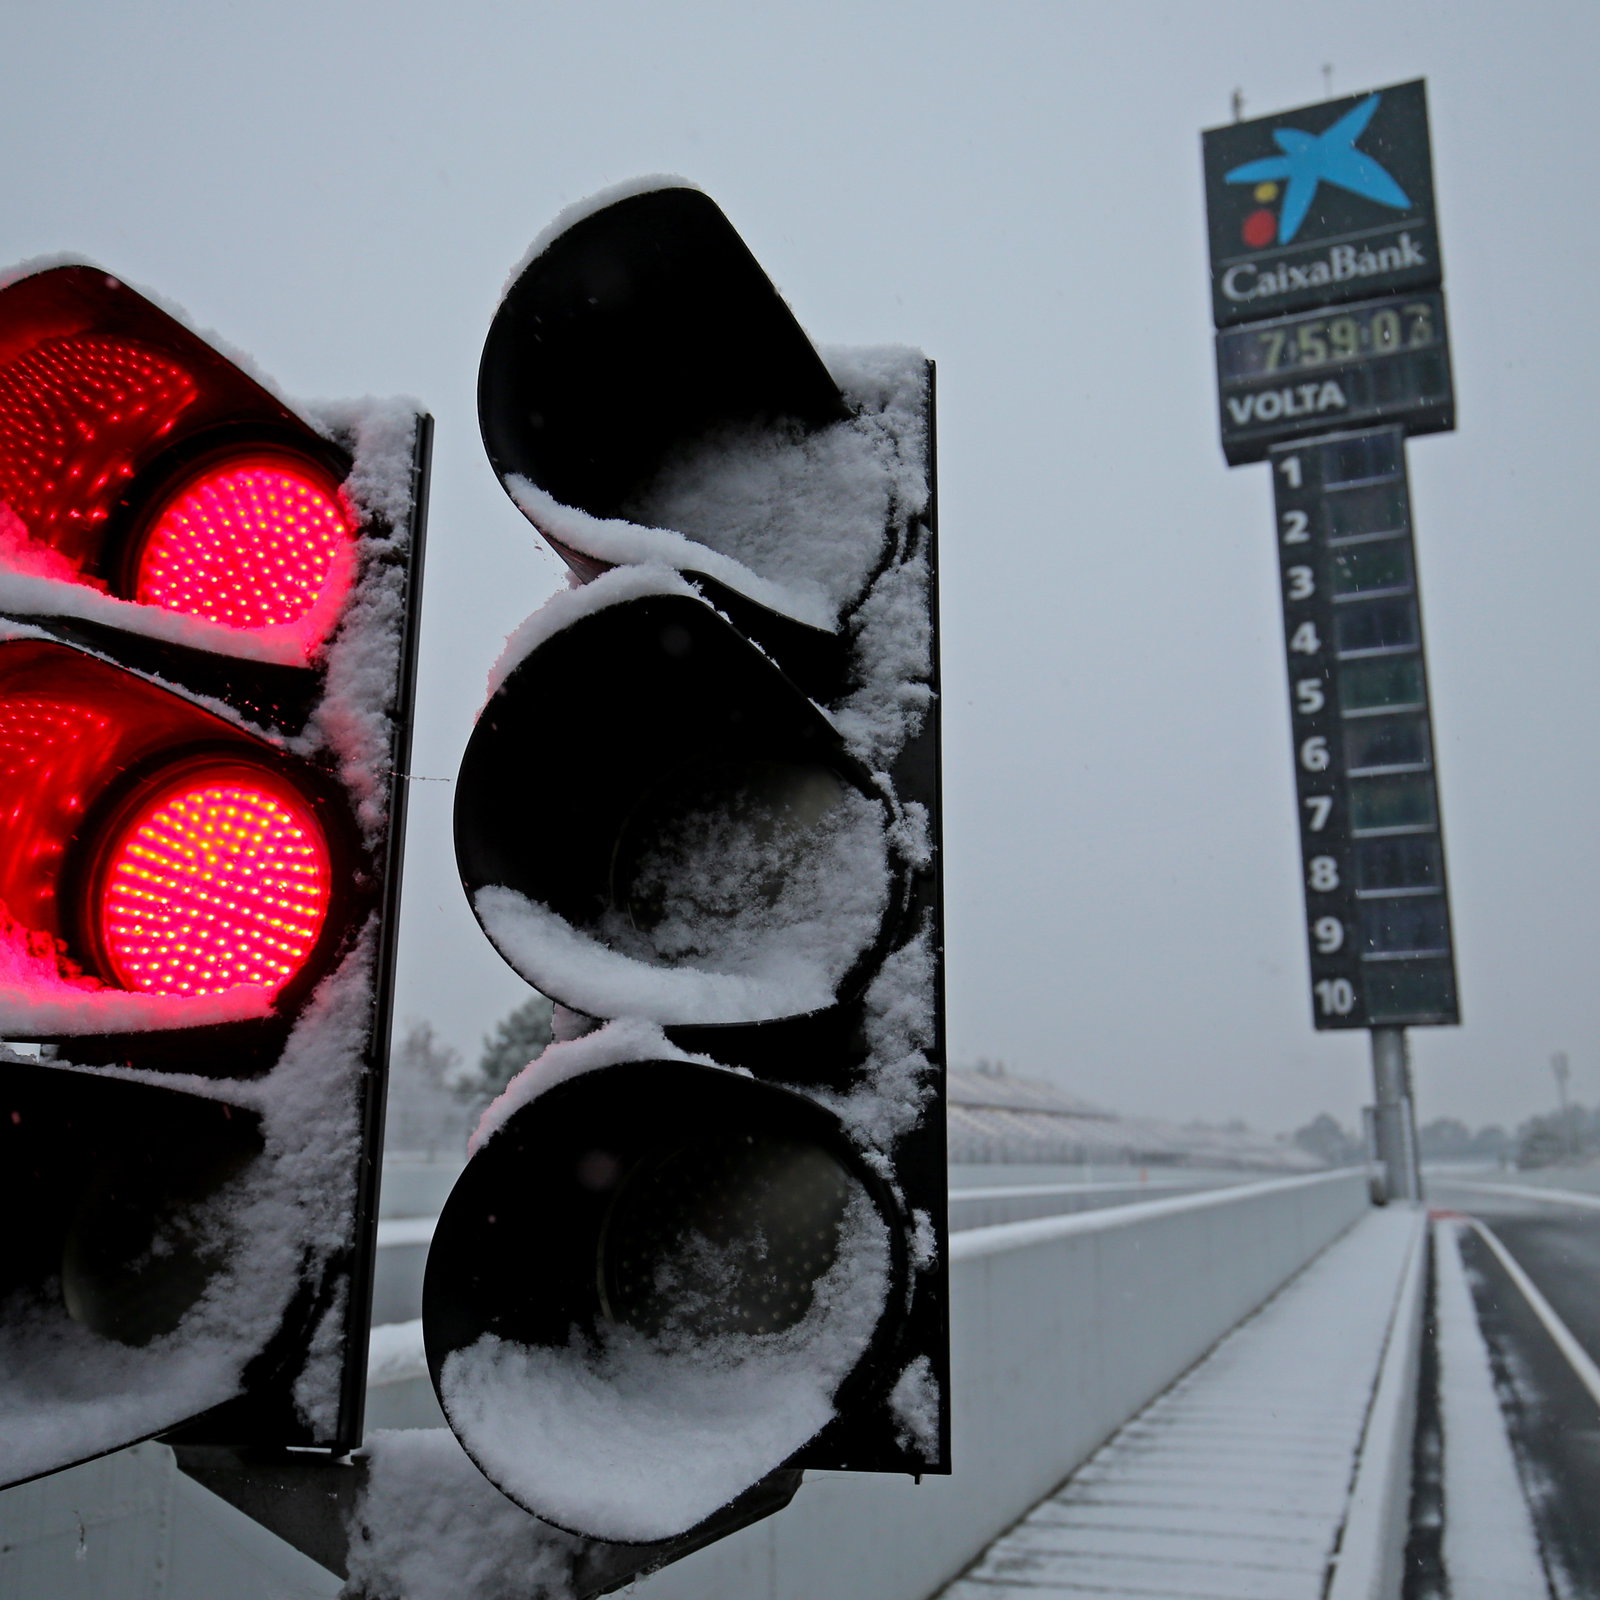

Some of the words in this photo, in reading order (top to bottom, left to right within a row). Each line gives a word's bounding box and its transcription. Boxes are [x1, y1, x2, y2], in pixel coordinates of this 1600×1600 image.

[1222, 232, 1425, 302] CaixaBank
[1228, 380, 1347, 425] VOLTA
[1279, 456, 1302, 487] 1
[1282, 510, 1310, 544] 2
[1287, 566, 1315, 600] 3
[1291, 621, 1321, 655] 4
[1297, 679, 1324, 714] 5
[1301, 737, 1330, 772] 6
[1304, 796, 1332, 831] 7
[1310, 856, 1339, 892] 8
[1315, 917, 1344, 953] 9
[1314, 978, 1354, 1015] 10
